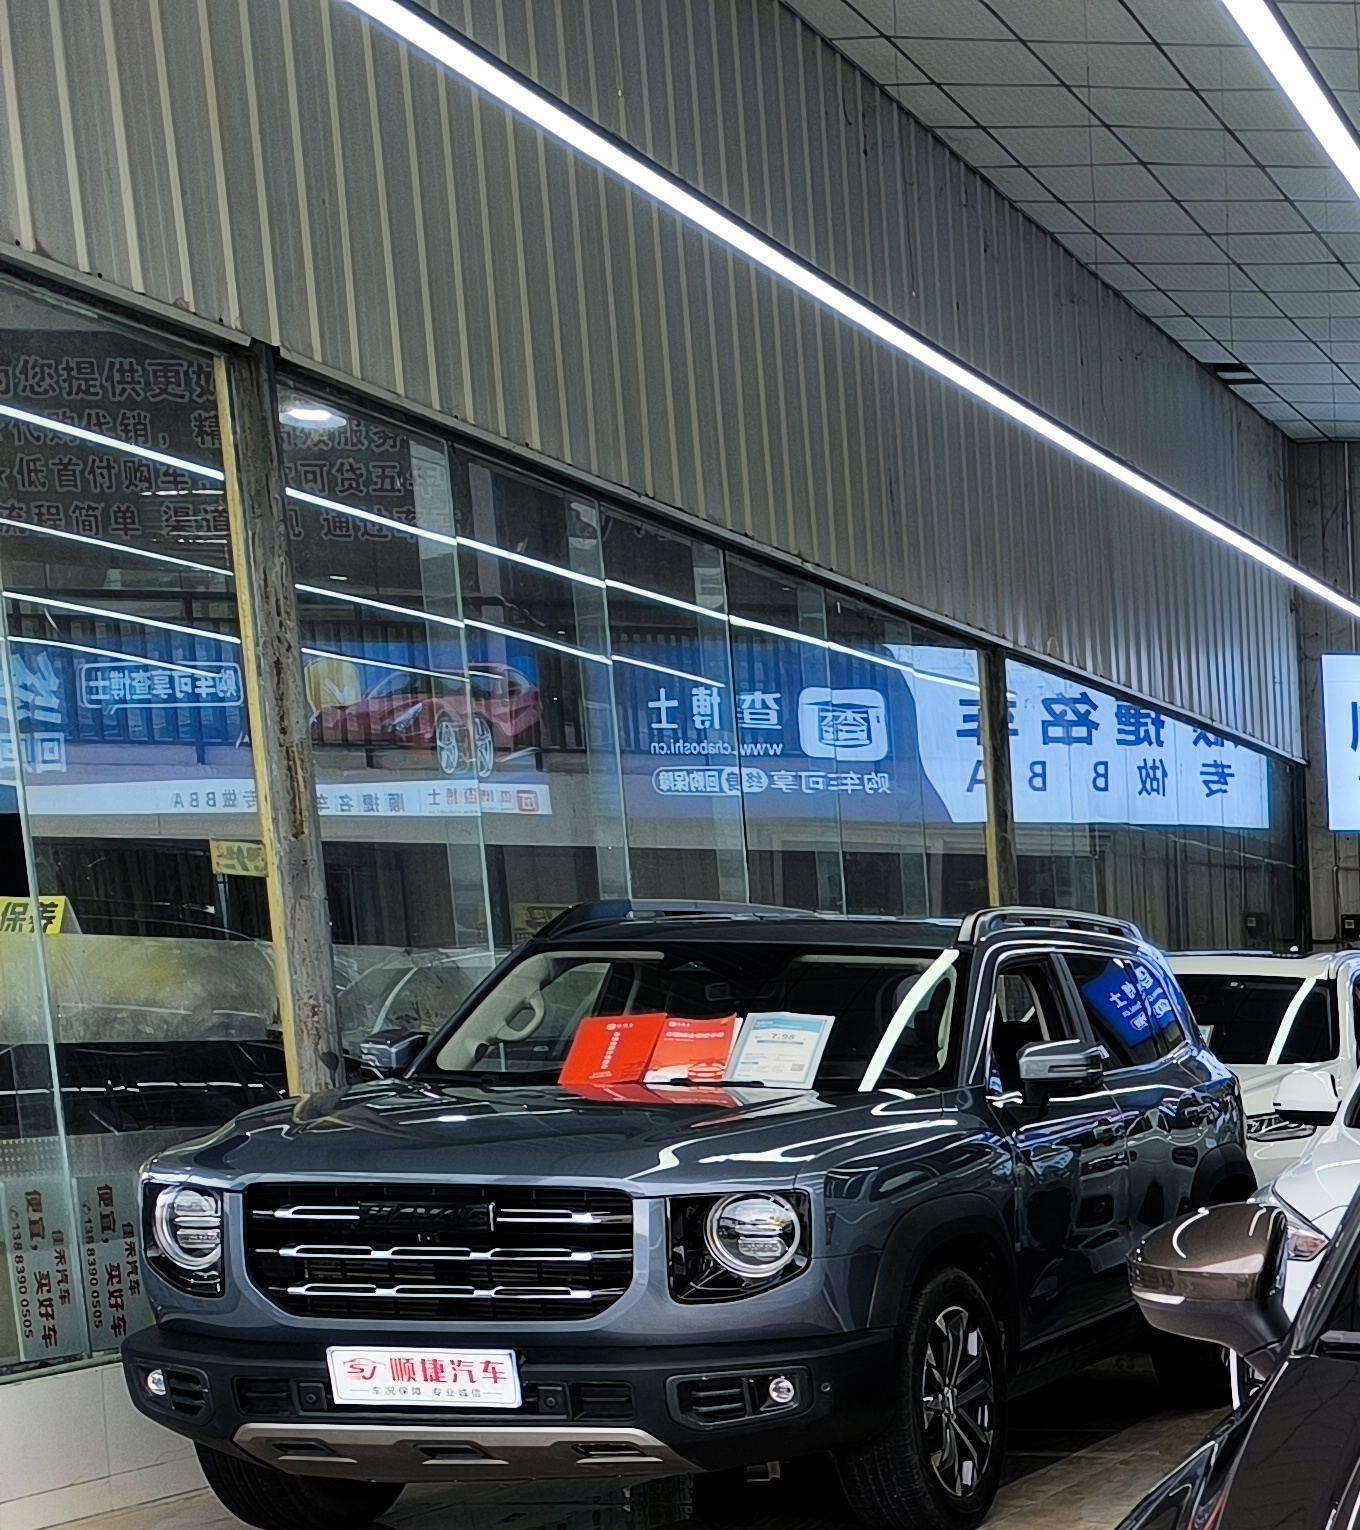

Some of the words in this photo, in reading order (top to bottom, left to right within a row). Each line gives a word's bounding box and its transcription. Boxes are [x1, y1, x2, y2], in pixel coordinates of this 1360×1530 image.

[389, 1357, 507, 1384] 顺捷汽车
[371, 1386, 422, 1396] 车况保障
[432, 1387, 482, 1398] 专业诚信
